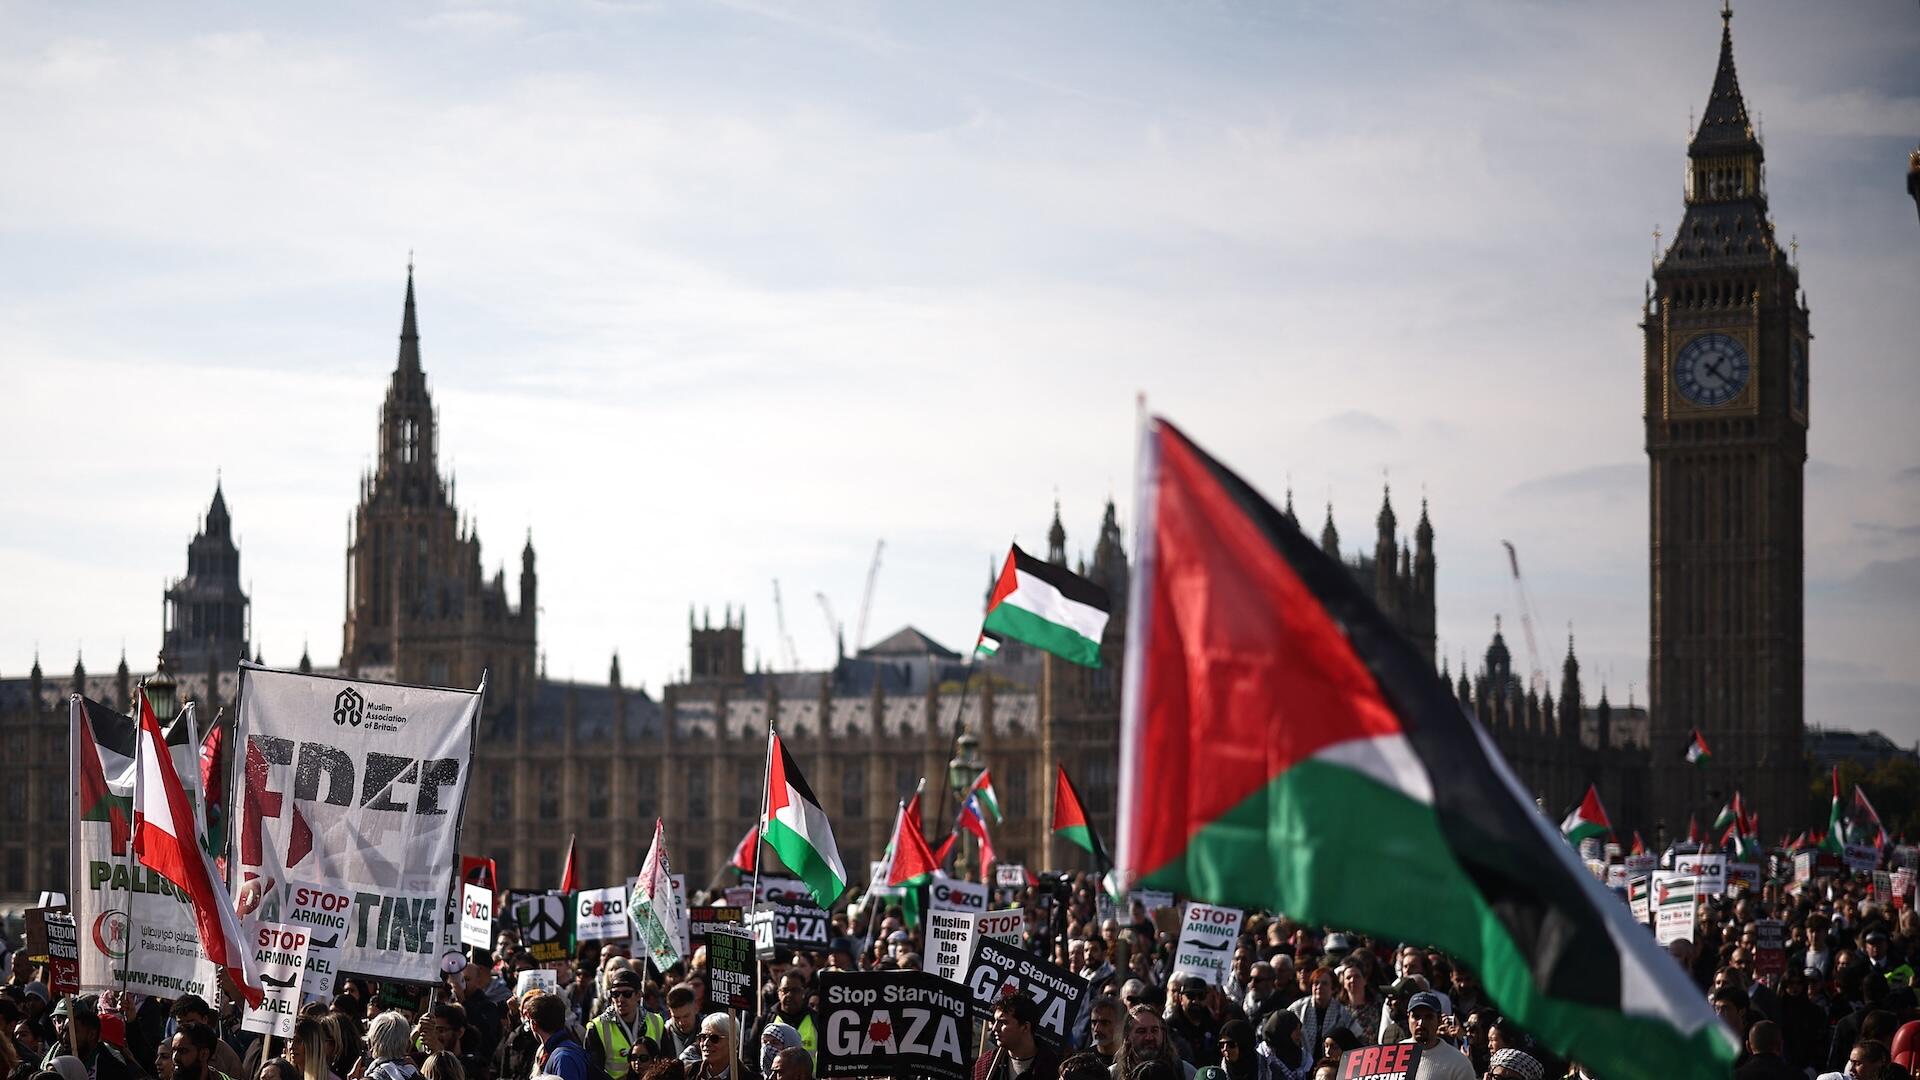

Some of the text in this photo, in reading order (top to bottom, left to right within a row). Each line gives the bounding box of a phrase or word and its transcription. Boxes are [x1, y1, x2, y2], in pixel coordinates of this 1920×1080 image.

[367, 702, 392, 712] Muslim
[365, 712, 407, 723] Association
[373, 722, 398, 732] Britain
[1679, 863, 1720, 876] Gza
[90, 860, 192, 904] PALES
[296, 888, 350, 913] STOP
[935, 885, 982, 907] Gza
[464, 895, 489, 921] Gza
[581, 899, 622, 917] Gza
[1190, 907, 1237, 925] STOP
[291, 908, 345, 929] ARMING
[932, 915, 970, 929] Muslim
[977, 916, 1020, 934] STOP
[48, 925, 75, 940] FREEDOM
[774, 914, 828, 942] GAZA
[933, 928, 967, 941] Rulers
[1187, 923, 1235, 937] ARMING
[141, 939, 175, 954] Palestinian
[176, 945, 194, 957] Forum
[258, 929, 306, 951] STOP
[711, 934, 750, 951] FROM THE
[941, 941, 957, 953] the
[48, 942, 78, 959] PALESTINE
[256, 950, 302, 967] ARMING
[711, 945, 746, 961] RIVER TO
[937, 953, 960, 965] Real
[306, 957, 333, 975] AEL
[712, 956, 743, 973] THE SEA
[1179, 954, 1227, 970] ISRAEL
[711, 968, 751, 986] PALESTINE
[940, 967, 955, 979] IDF
[981, 947, 1079, 1000] Stop Starving
[114, 969, 205, 995] WWW.PFBUK.COM
[711, 979, 742, 996] WILL BE
[260, 997, 293, 1015] RAEL
[711, 991, 730, 1005] FREE
[828, 985, 965, 1017] Stop Starving
[826, 1008, 963, 1065] GAZA
[1345, 1044, 1413, 1079] FREE
